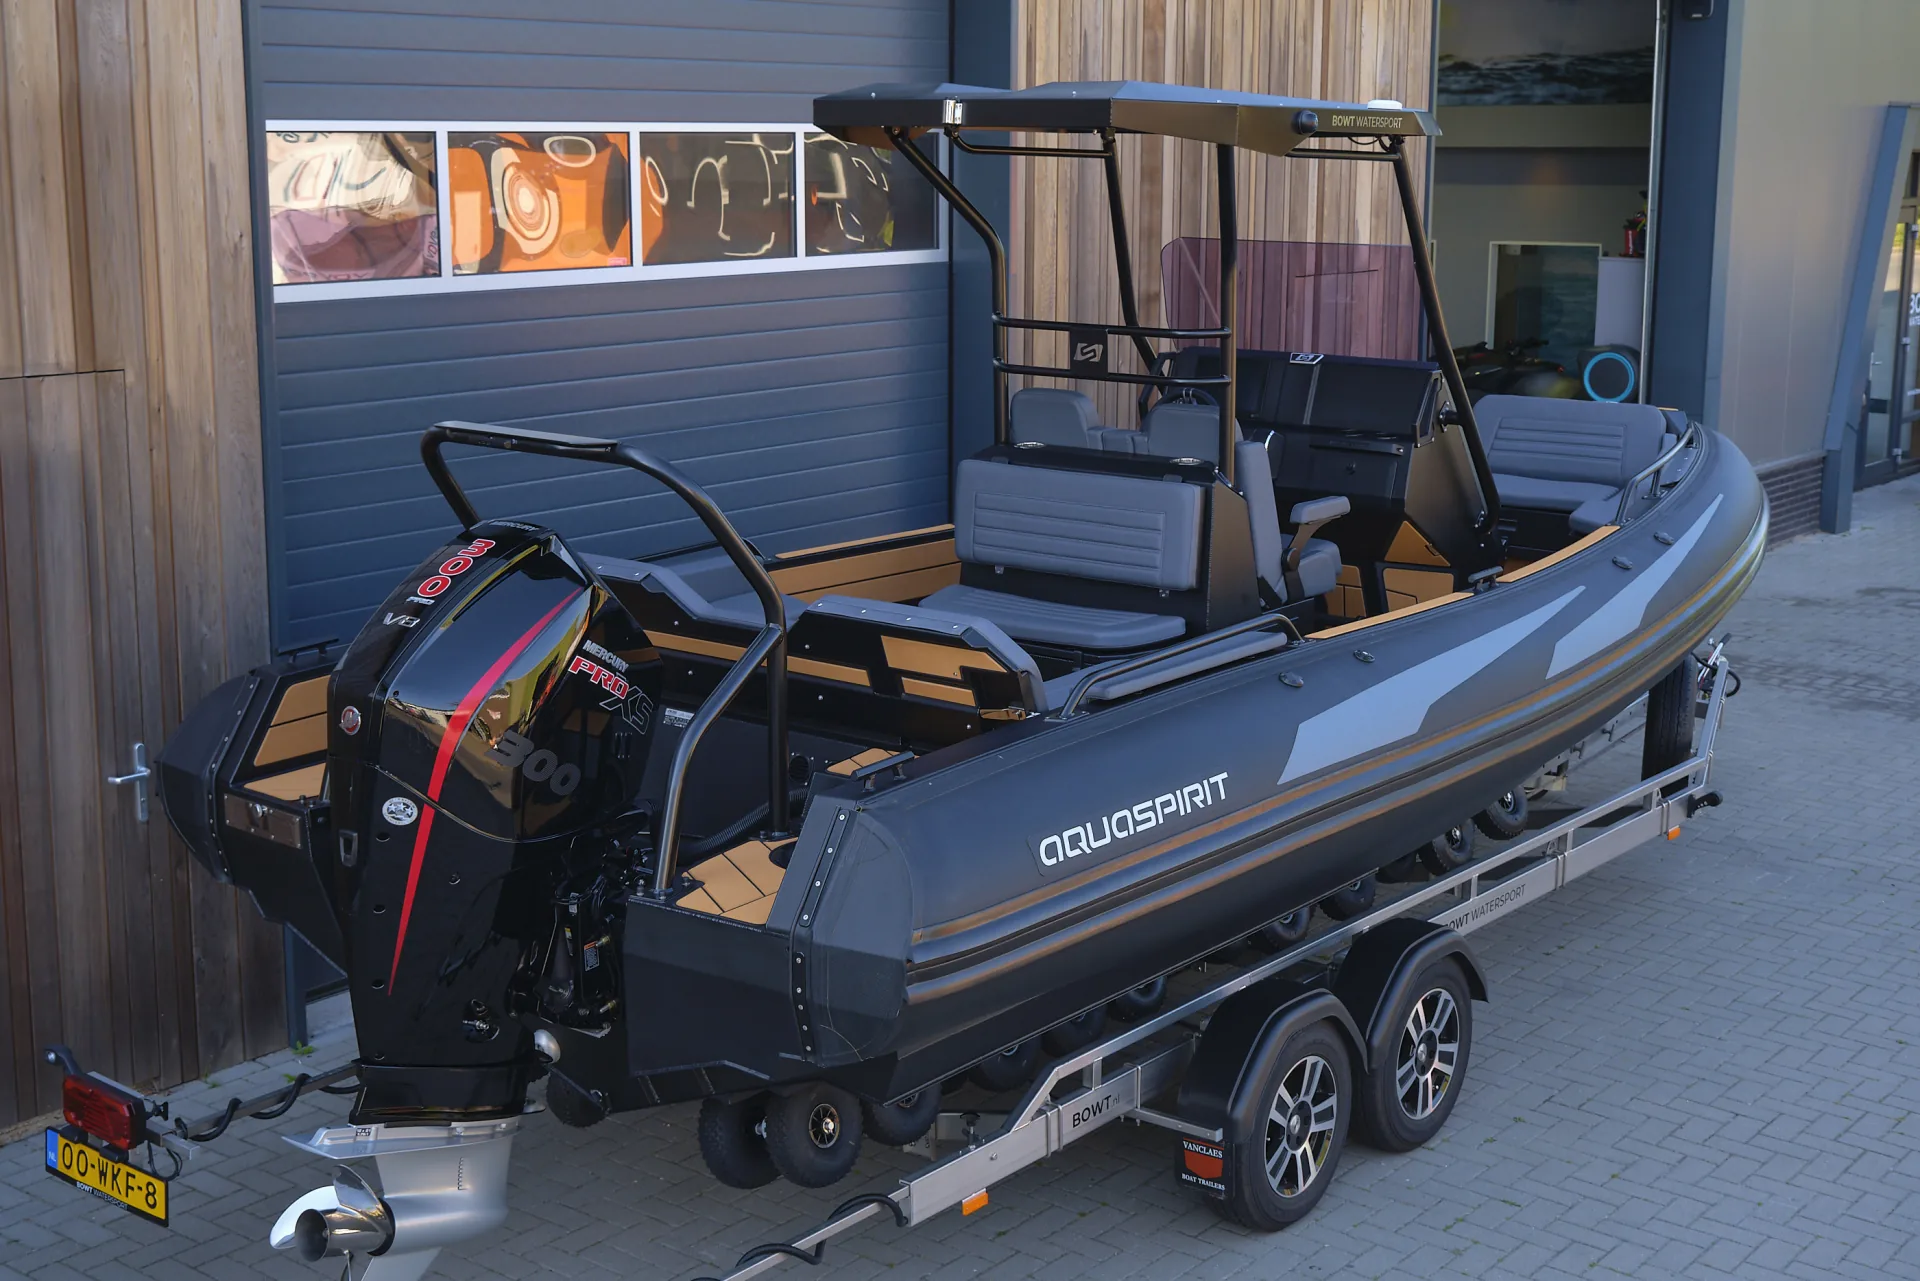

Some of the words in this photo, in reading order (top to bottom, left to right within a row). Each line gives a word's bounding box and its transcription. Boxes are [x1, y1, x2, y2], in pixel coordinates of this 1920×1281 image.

[1332, 115, 1355, 127] BOWT
[1356, 116, 1403, 129] WATERSPORT
[413, 538, 496, 598] 300
[382, 612, 421, 628] V8
[582, 639, 630, 673] MERCURY
[568, 655, 630, 700] PRO
[599, 685, 654, 735] XS
[484, 729, 582, 796] 300
[1038, 771, 1229, 867] AQUASPIRIT
[1444, 912, 1470, 930] OWT
[1471, 883, 1526, 921] WATERSPORT
[48, 1151, 57, 1162] NL
[1182, 1140, 1223, 1159] VANCLAES
[62, 1142, 158, 1210] 00-WKF-8
[1181, 1172, 1198, 1183] BOAT
[1197, 1178, 1226, 1191] TRAILERS
[76, 1181, 93, 1193] BOWT
[93, 1187, 128, 1211] WATERSPORT
